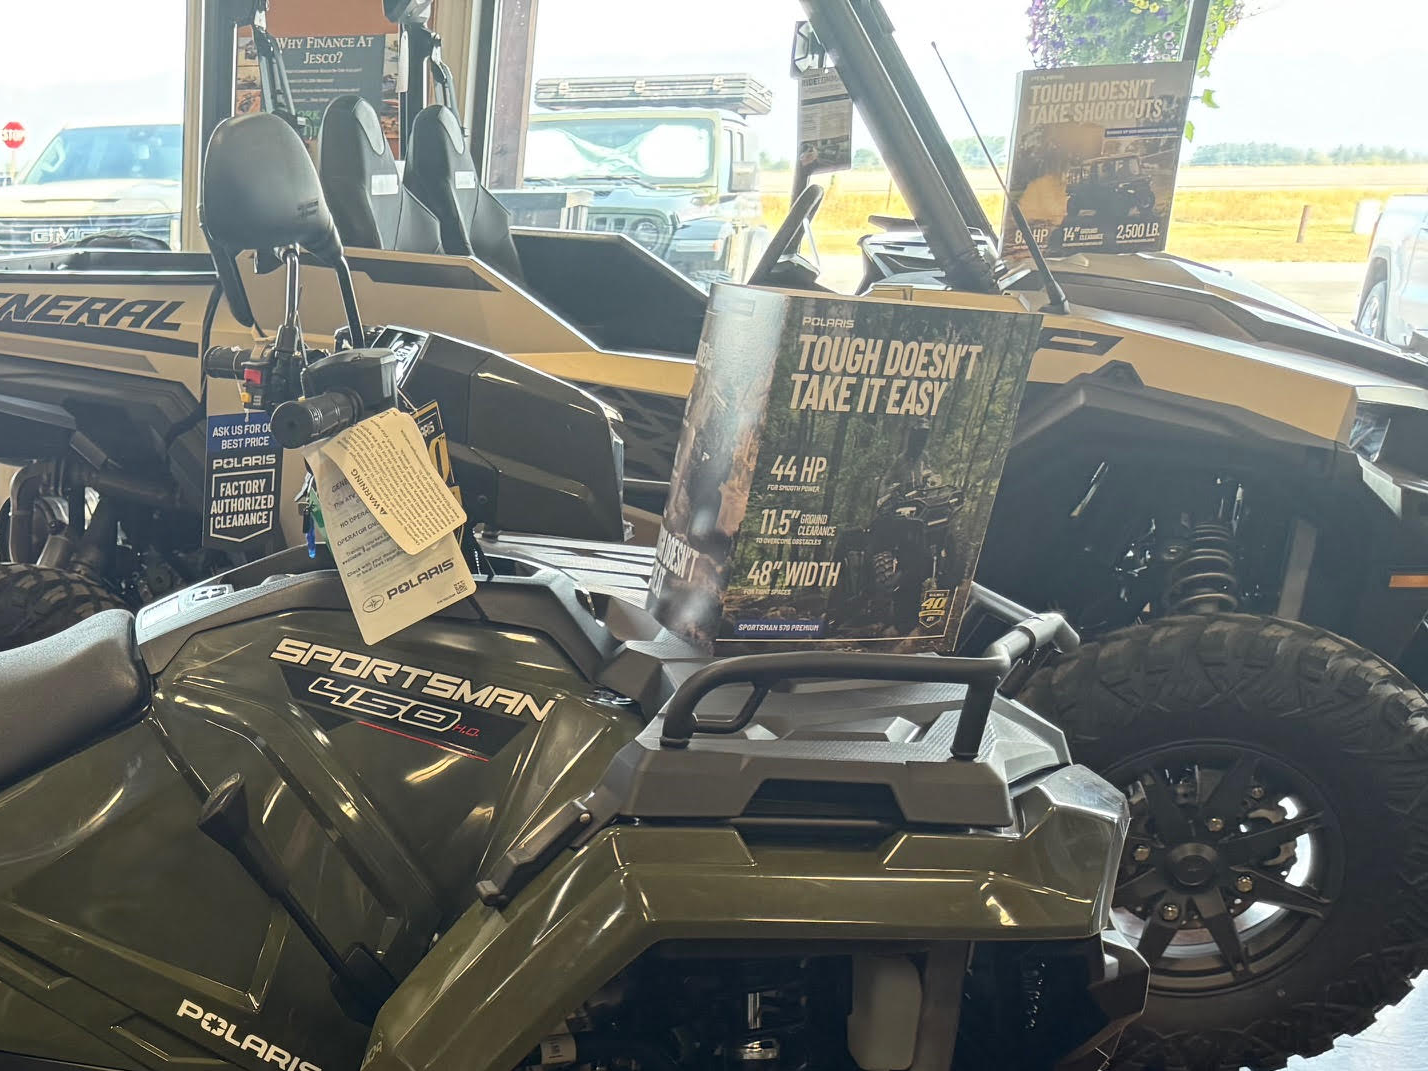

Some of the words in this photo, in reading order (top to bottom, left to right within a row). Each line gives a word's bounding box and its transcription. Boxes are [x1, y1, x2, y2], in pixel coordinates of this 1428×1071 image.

[306, 36, 355, 48] FINANCE
[357, 36, 374, 47] AT
[303, 51, 343, 64] JESCO?
[1030, 84, 1087, 105] TOUGH
[1088, 79, 1156, 102] DOESN'T
[1028, 105, 1073, 125] TAKE
[1073, 99, 1164, 122] SHORTCUTS
[1, 129, 26, 142] STOP
[1034, 228, 1049, 242] HP
[1116, 223, 1145, 240] 2,500
[1146, 222, 1160, 237] LB.
[802, 316, 855, 329] POLARIS
[798, 334, 884, 376] TOUGH
[885, 340, 983, 380] DOESN'T
[789, 373, 852, 412] TAKE
[856, 377, 887, 414] IT
[886, 380, 948, 416] EASY
[212, 425, 230, 438] ASK
[231, 424, 243, 436] US
[244, 422, 262, 435] FOR
[221, 438, 243, 450] BEST
[245, 436, 270, 447] PRICE
[212, 454, 276, 470] POLARIS
[771, 455, 797, 482] 44
[800, 456, 827, 483] HP
[220, 479, 266, 496] FACTORY
[351, 468, 381, 508] WARNING
[210, 494, 275, 515] AUTHORIZED
[214, 511, 269, 529] CLEARANCE
[349, 509, 371, 524] OPERA
[759, 508, 800, 536] 11.5"
[800, 513, 829, 525] GROUND
[797, 525, 837, 536] CLEARANCE
[386, 558, 455, 600] POLARIS
[747, 560, 783, 587] 48"
[785, 561, 842, 587] WIDTH
[921, 597, 948, 610] 40
[738, 623, 778, 632] SPORTSMAN
[778, 624, 791, 632] 570
[791, 624, 820, 632] PREMIUM
[270, 637, 556, 721] SPORTSMAN
[308, 677, 462, 732] 450
